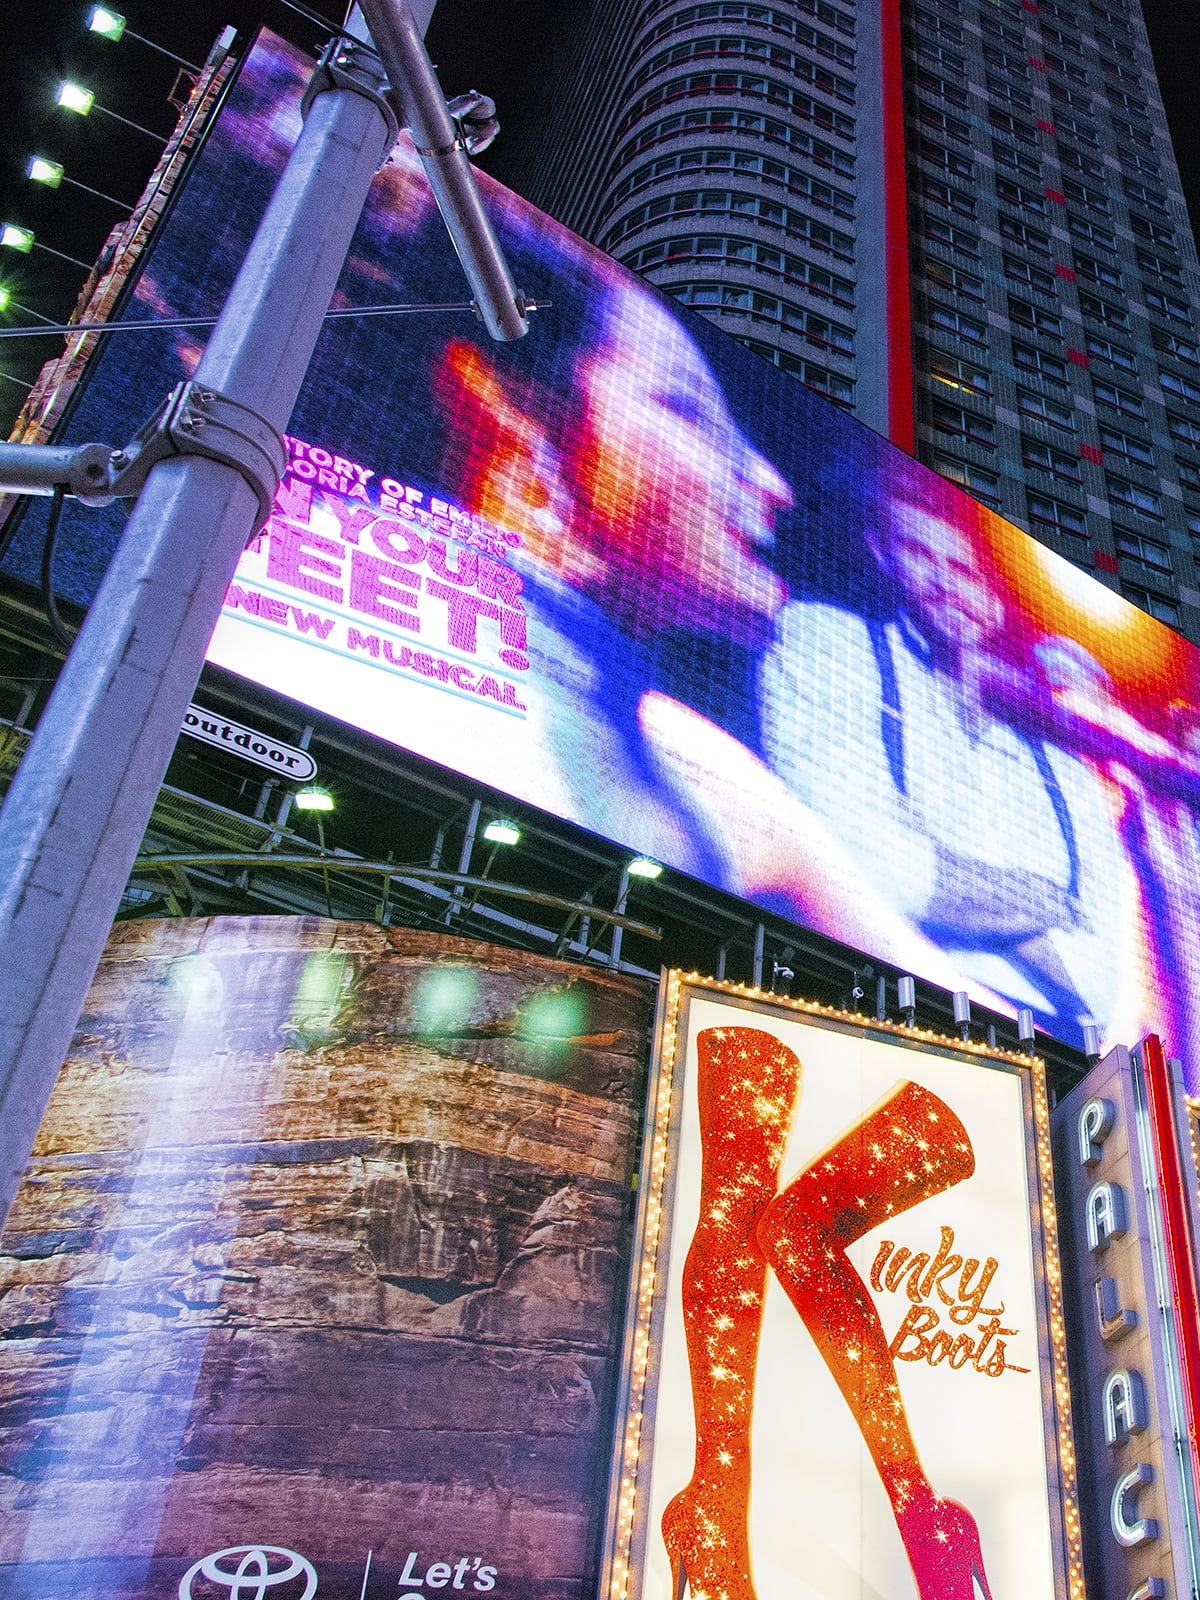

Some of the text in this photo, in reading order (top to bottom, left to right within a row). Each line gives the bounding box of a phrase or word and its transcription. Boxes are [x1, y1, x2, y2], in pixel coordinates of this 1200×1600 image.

[273, 476, 528, 612] N YOUR
[285, 458, 507, 559] ORIA ESTEFAN
[381, 476, 424, 506] OF
[432, 496, 526, 549] EMILIO
[250, 516, 531, 671] EET!
[225, 584, 528, 712] NEW MUSICAL
[185, 712, 301, 769] outdoor
[888, 1304, 1032, 1377] Boots
[398, 1552, 498, 1591] Let's
